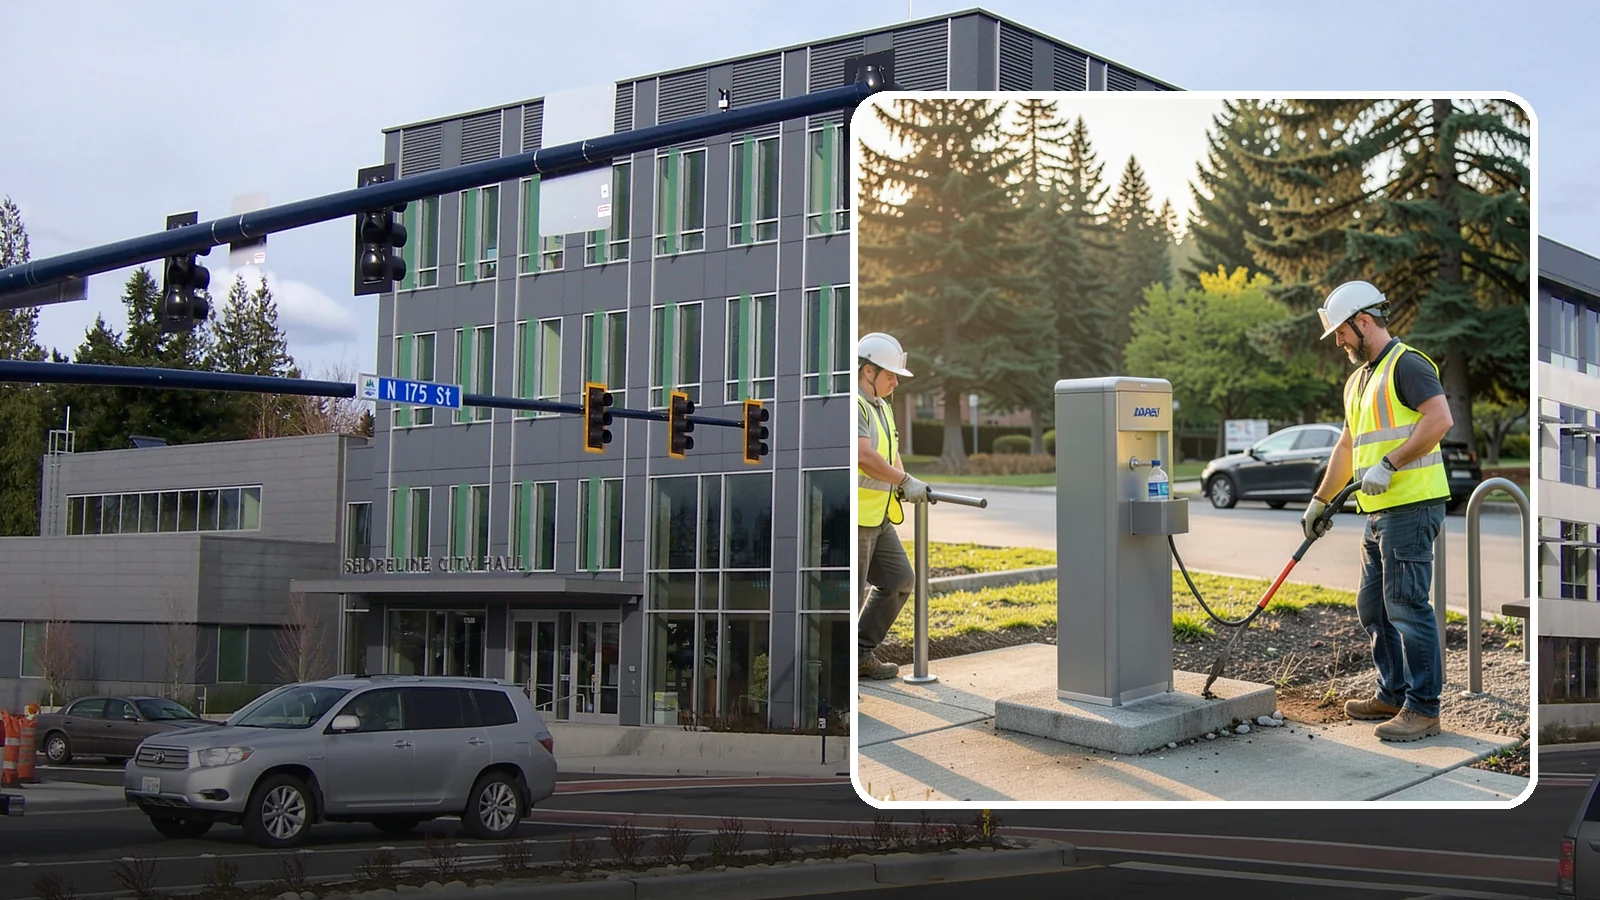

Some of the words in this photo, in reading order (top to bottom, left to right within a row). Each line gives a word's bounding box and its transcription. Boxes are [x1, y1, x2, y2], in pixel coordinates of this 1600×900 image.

[387, 380, 396, 400] N
[405, 382, 427, 403] 175
[436, 386, 451, 406] St
[344, 556, 432, 574] SHORELINE
[438, 556, 475, 573] CITY
[484, 555, 526, 572] HALL
